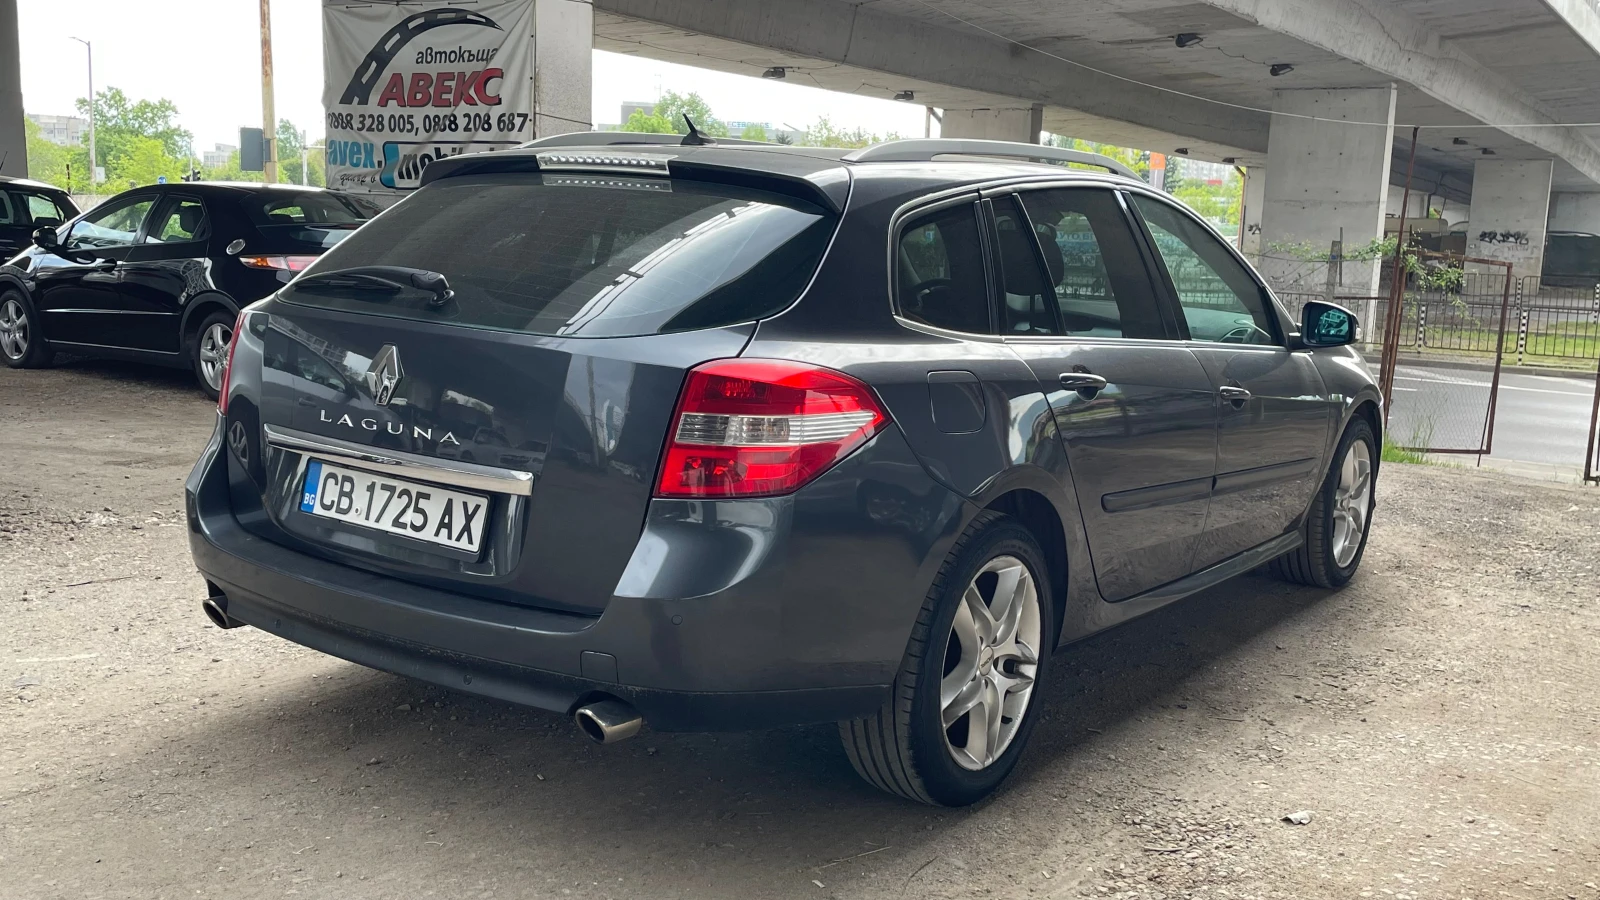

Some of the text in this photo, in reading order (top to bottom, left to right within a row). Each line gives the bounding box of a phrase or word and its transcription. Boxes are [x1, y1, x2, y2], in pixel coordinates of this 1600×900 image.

[415, 46, 499, 64] автокъща
[377, 68, 504, 107] АВЕКС
[356, 113, 385, 132] 328
[388, 113, 419, 136] 005,
[423, 113, 459, 133] 0888
[463, 112, 492, 132] 208
[497, 112, 529, 133] 687
[320, 409, 461, 446] LAGUNA
[303, 492, 316, 505] BG
[365, 480, 431, 533] 1725
[434, 497, 481, 545] AX
